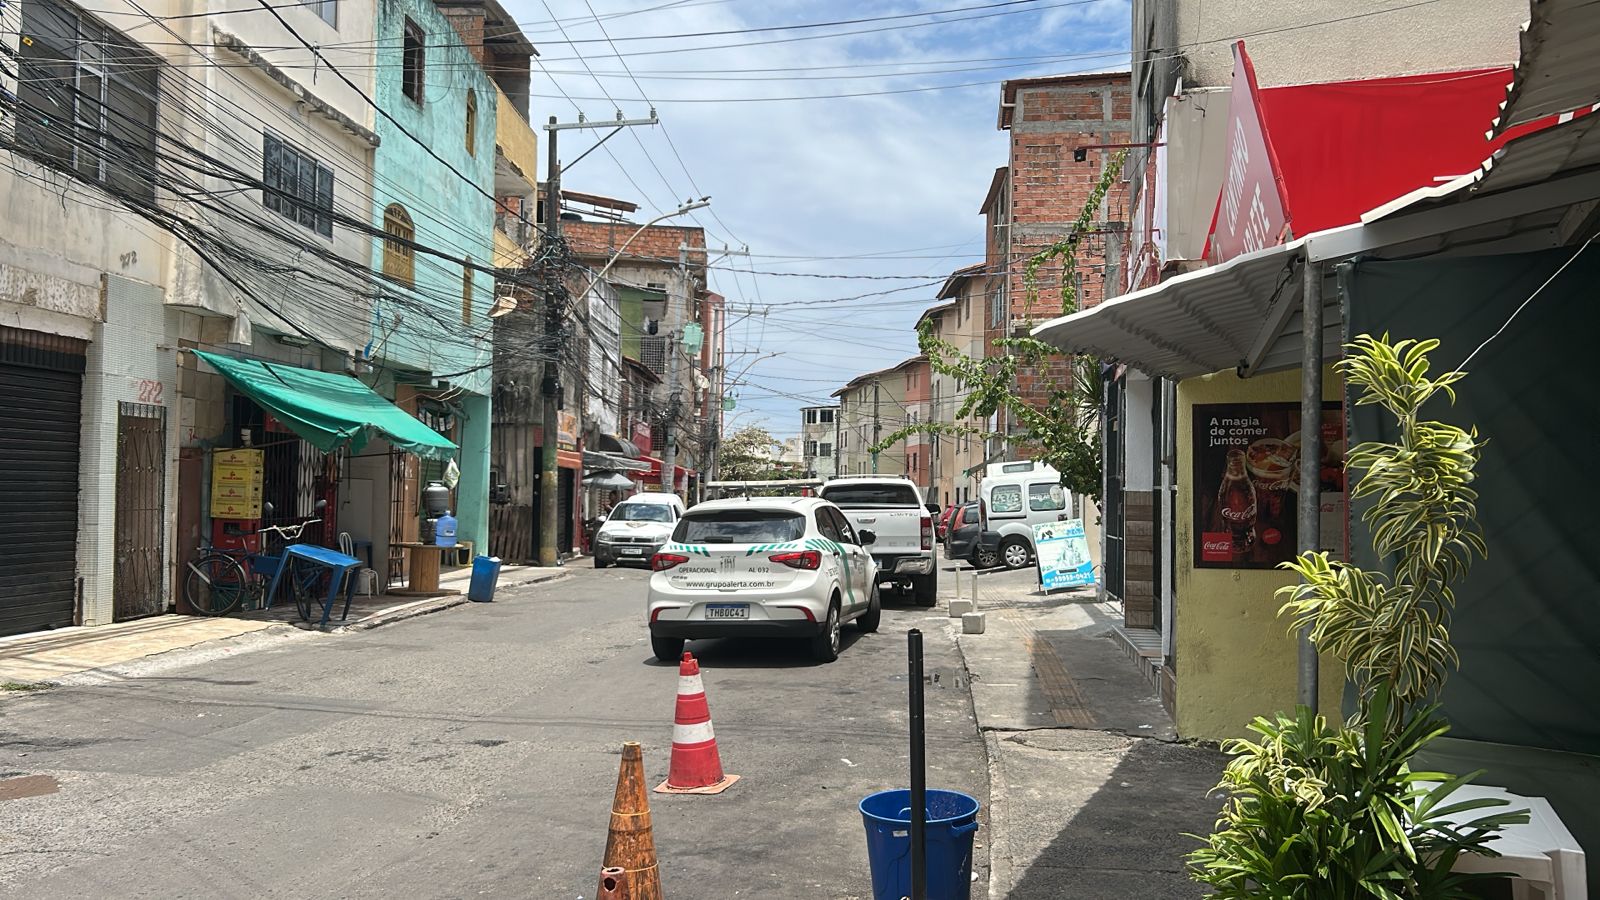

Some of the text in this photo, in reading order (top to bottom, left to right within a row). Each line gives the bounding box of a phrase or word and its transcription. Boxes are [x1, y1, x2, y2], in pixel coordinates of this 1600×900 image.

[1225, 116, 1249, 237] CANTINHO
[138, 379, 163, 404] 272
[1210, 416, 1260, 428] A magia
[1210, 427, 1268, 436] de comer
[1209, 436, 1249, 447] juntos
[678, 566, 717, 574] OPERACIONAL
